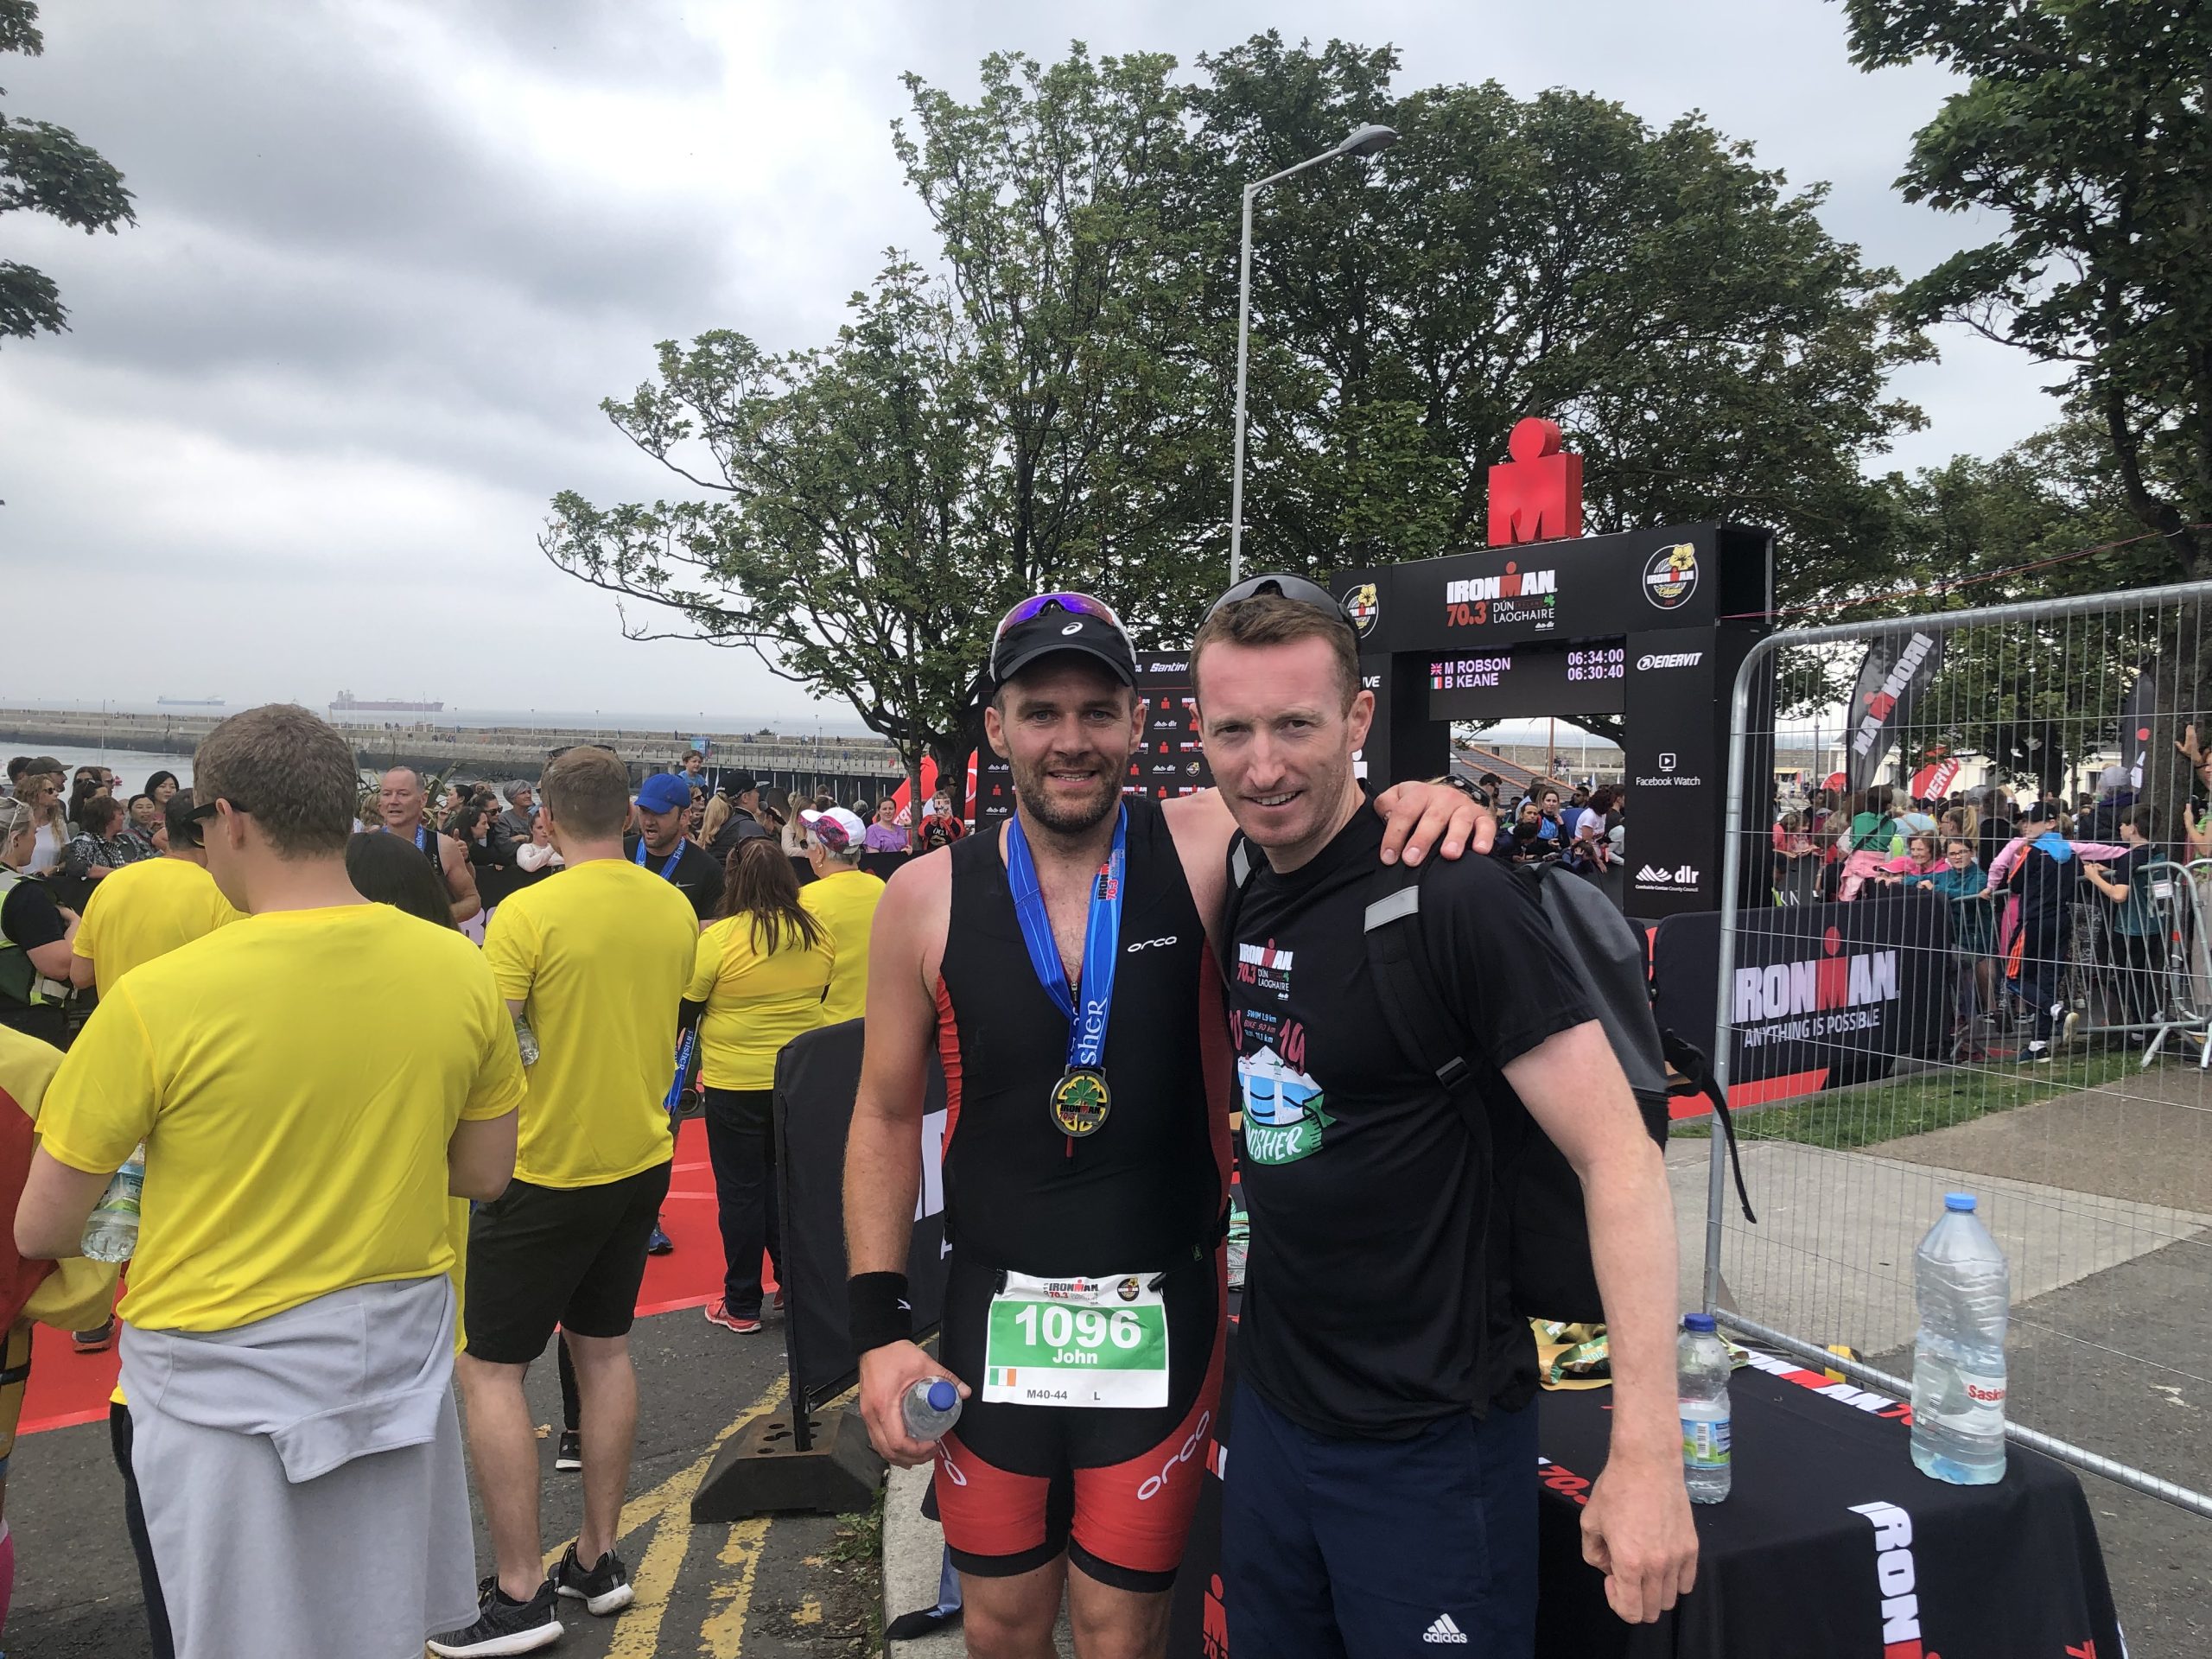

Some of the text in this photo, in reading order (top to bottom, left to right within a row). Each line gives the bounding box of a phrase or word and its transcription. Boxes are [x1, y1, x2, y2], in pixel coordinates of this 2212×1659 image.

[1446, 569, 1555, 604] IRONMAN
[1446, 601, 1486, 627] 70.3
[1493, 601, 1515, 613] DÚN
[1493, 608, 1555, 623] LAOGHAIRE
[1567, 649, 1624, 665] 06:34:00
[1653, 652, 1702, 669] ENERVIT
[1150, 662, 1189, 672] Santini
[1444, 658, 1510, 674] M ROBSON
[1567, 664, 1624, 681] 06:30:40
[1444, 673, 1499, 689] B KEANE
[1636, 777, 1700, 785] Facebook Watch
[1675, 866, 1699, 883] dlr
[1127, 936, 1177, 952] orca
[1238, 943, 1293, 970] IRONMAN
[1236, 962, 1256, 984] 70.3
[1258, 977, 1290, 992] LAOGHAIRE
[1731, 950, 1897, 1024] RONMAN
[1246, 1009, 1262, 1020] SWIM
[1244, 1020, 1256, 1029] BIKE
[1744, 1007, 1880, 1048] ANYTHING IS POSSIBLE
[1264, 1033, 1273, 1044] km
[1060, 1103, 1100, 1115] IRONMAN
[1048, 1282, 1098, 1292] IRONMAN
[1015, 1304, 1141, 1349] 1096
[1052, 1348, 1098, 1364] John
[1027, 1389, 1101, 1401] M40-44 L
[1137, 1409, 1210, 1501] orca
[1422, 1630, 1468, 1643] adidas
